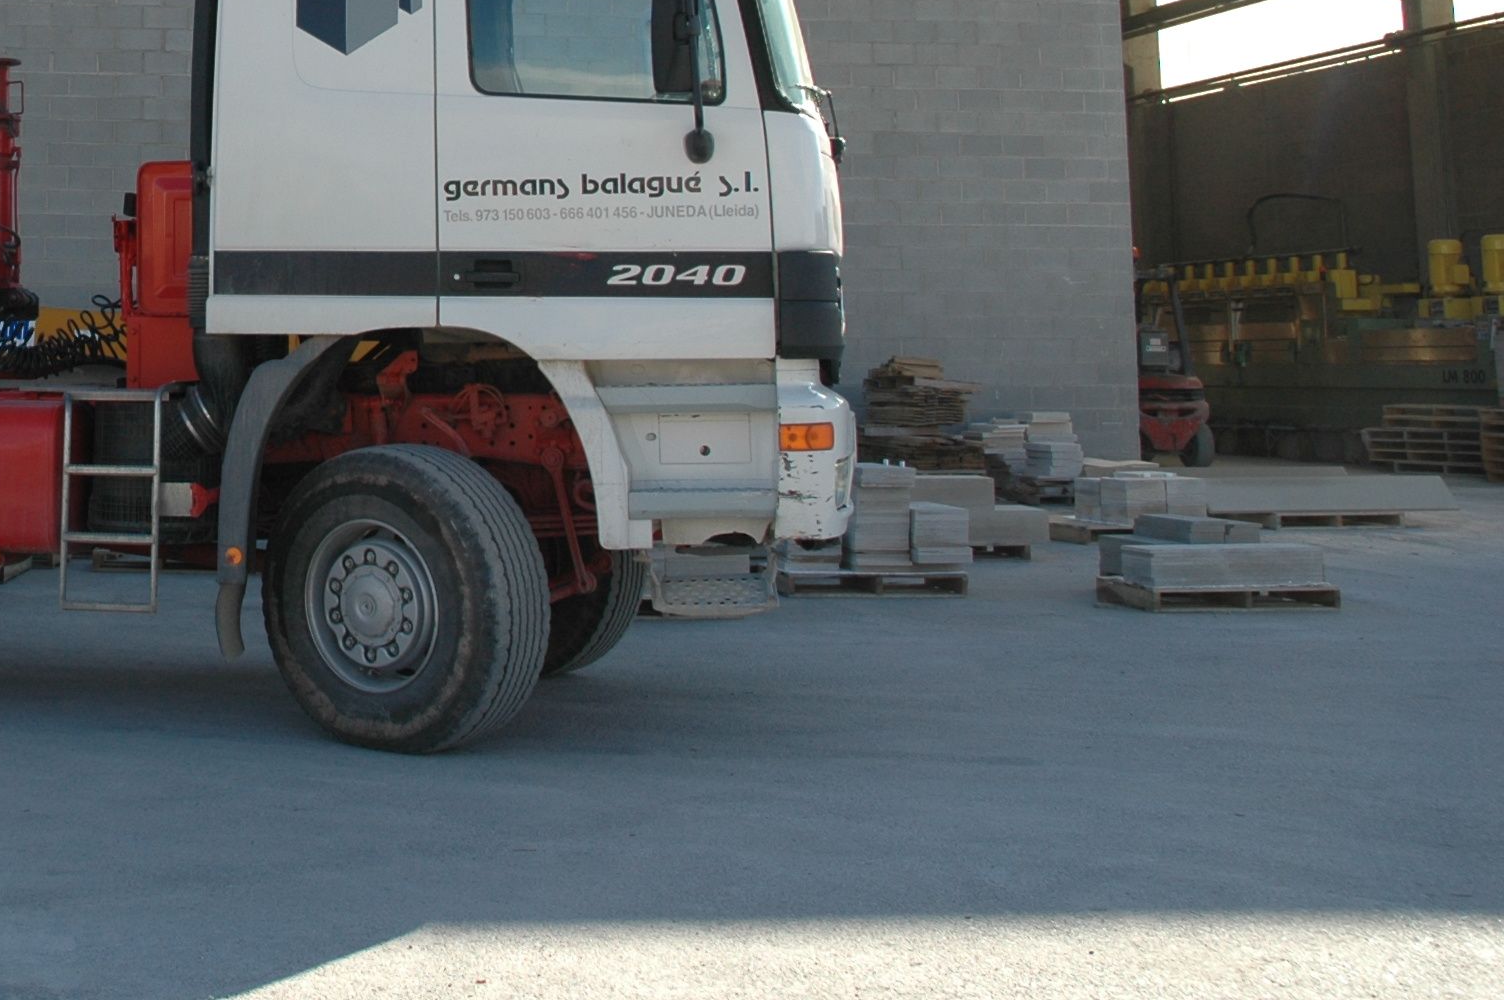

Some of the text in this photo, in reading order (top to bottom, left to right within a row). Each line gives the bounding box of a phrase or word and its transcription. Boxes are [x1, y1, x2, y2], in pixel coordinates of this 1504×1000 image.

[443, 178, 570, 202] germans
[581, 171, 702, 198] balagué
[443, 208, 473, 223] Tels.
[475, 208, 500, 222] 973
[503, 207, 525, 221] 150
[526, 206, 551, 220] 603
[559, 206, 584, 220] 666
[586, 205, 610, 219] 401
[612, 205, 638, 219] 456
[647, 204, 708, 219] JUNEDA
[708, 203, 760, 220] (Lleida)
[606, 264, 746, 286] 2040
[1442, 369, 1486, 384] LM 800
